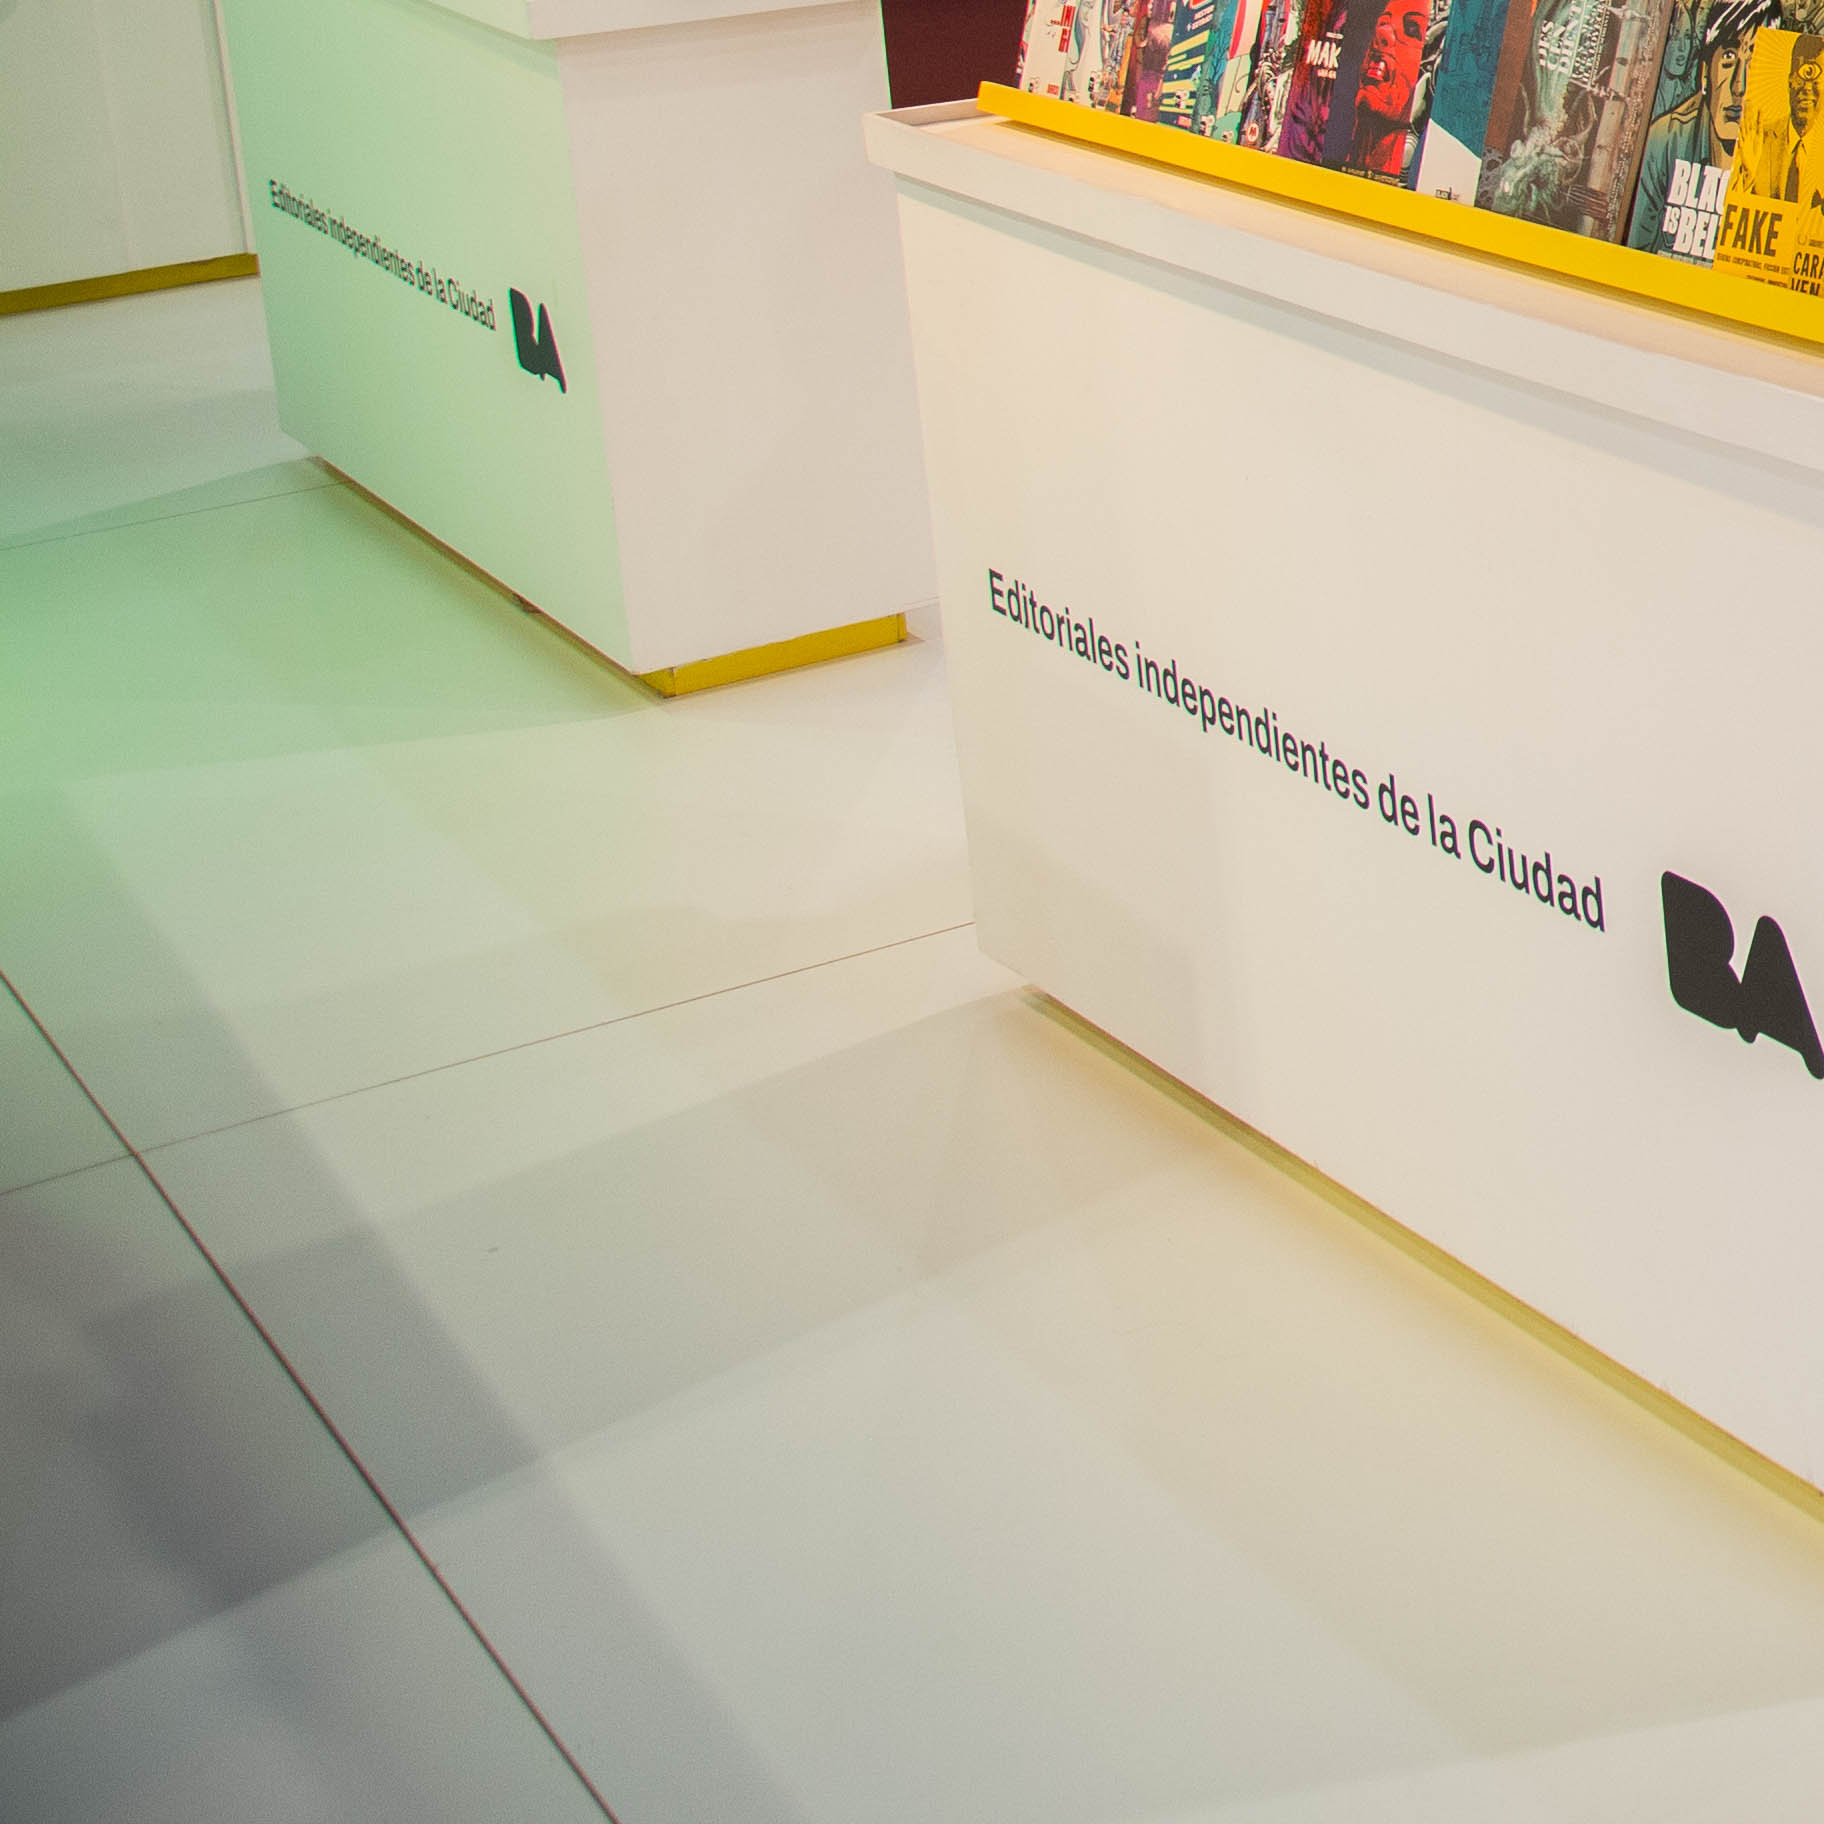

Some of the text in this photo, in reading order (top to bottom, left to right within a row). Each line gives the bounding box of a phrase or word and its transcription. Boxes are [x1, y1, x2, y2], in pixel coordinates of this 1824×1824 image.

[269, 179, 496, 331] Editoriales independientes de la Ciudad
[1663, 205, 1680, 234] IS
[1720, 204, 1783, 257] FAKE
[988, 568, 1606, 934] Editoriales independientes de la Ciudad
